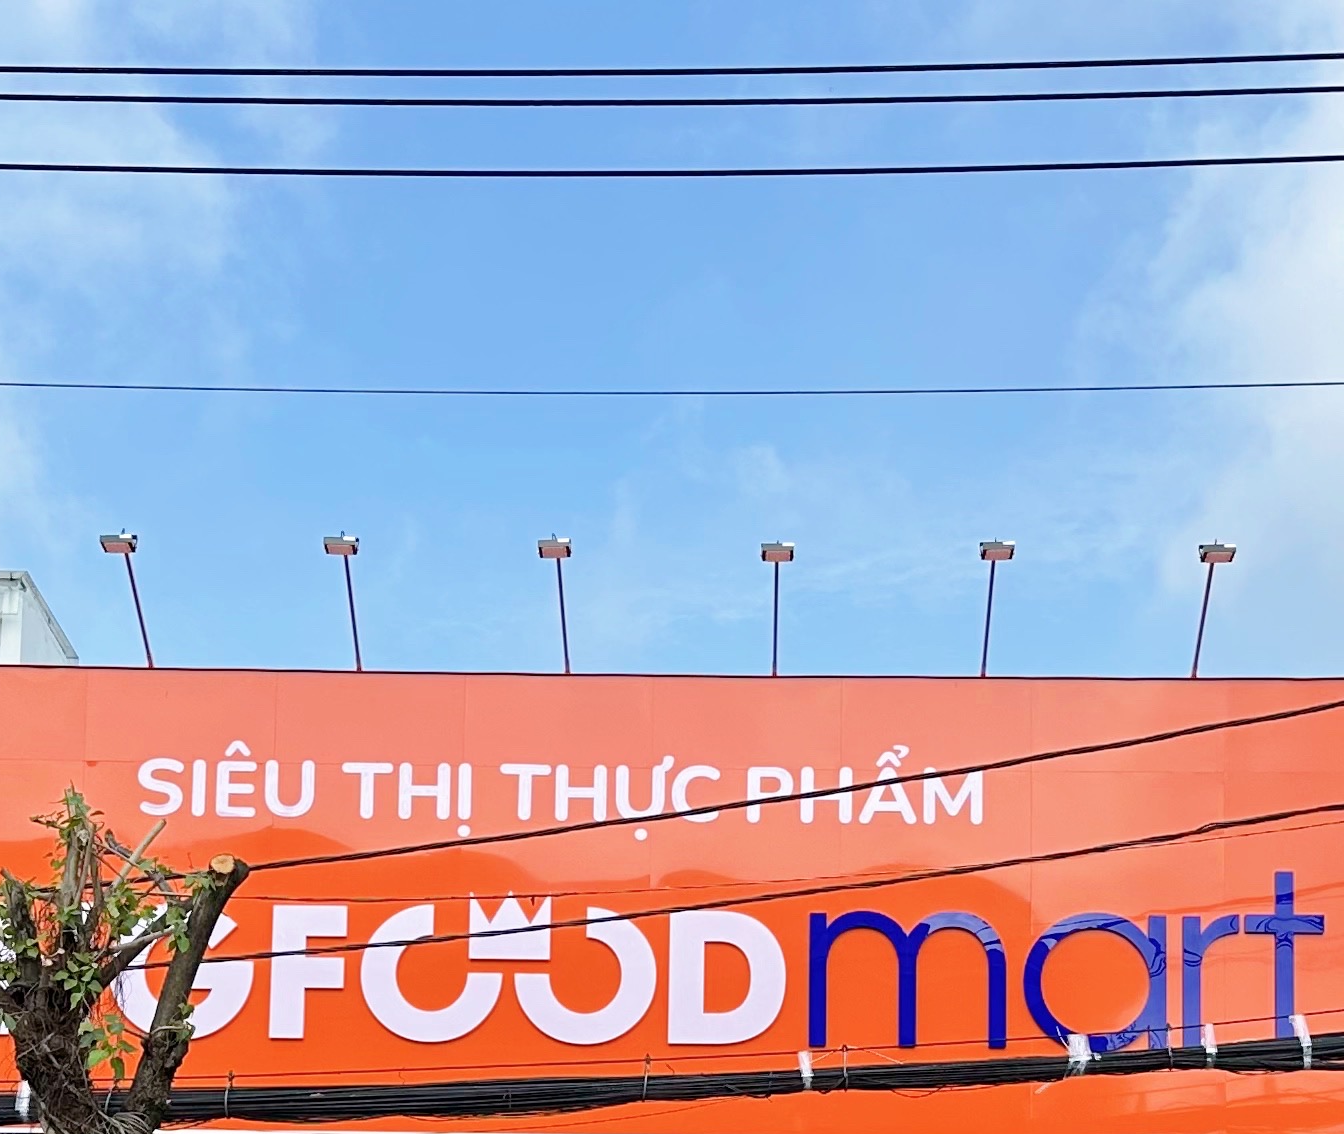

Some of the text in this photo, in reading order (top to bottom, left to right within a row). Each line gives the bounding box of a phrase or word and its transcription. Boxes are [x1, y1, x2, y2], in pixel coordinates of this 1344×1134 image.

[138, 740, 984, 841] SIÊU THỊ THỰC PHẨM
[807, 870, 1326, 1053] mart
